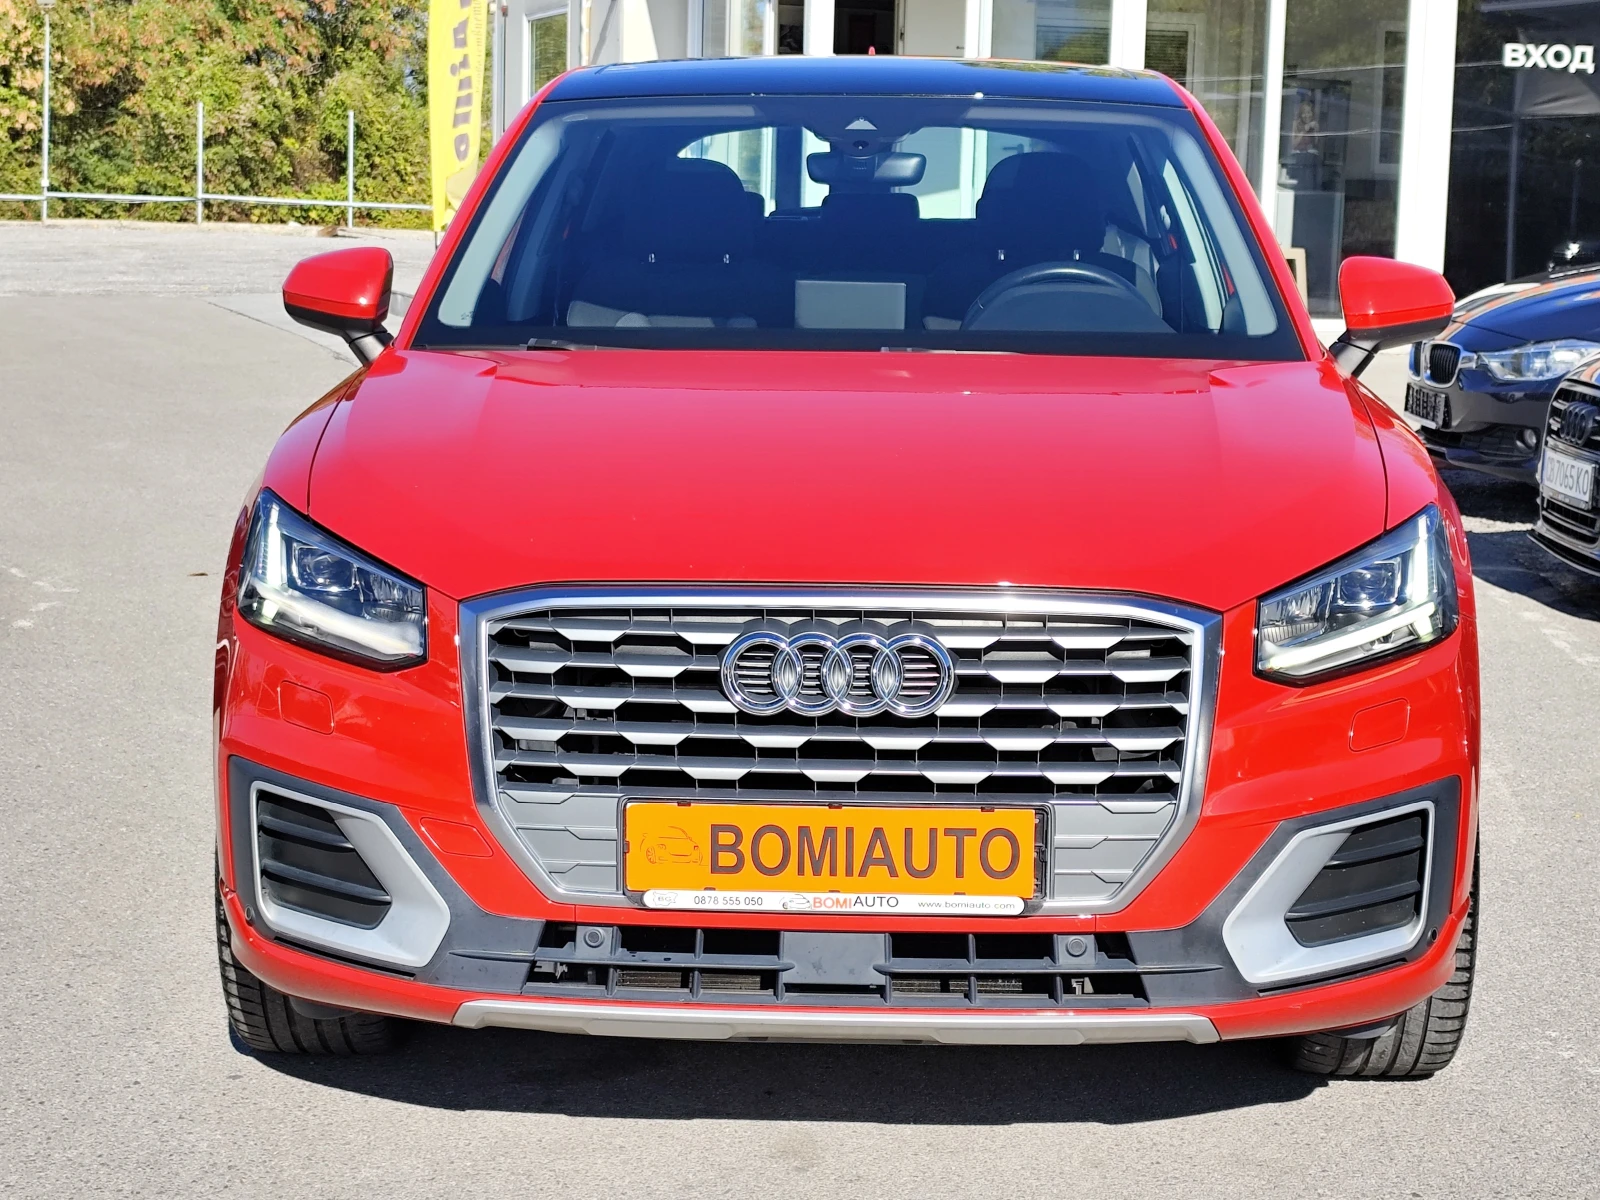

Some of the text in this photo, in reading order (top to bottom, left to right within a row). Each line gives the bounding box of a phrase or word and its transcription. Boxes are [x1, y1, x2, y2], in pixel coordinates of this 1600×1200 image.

[1503, 43, 1595, 74] ВХОД
[710, 823, 1021, 880] BOMIAUTO
[693, 895, 763, 906] 0878 555 050
[917, 900, 1015, 910] www.bomiauto.com
